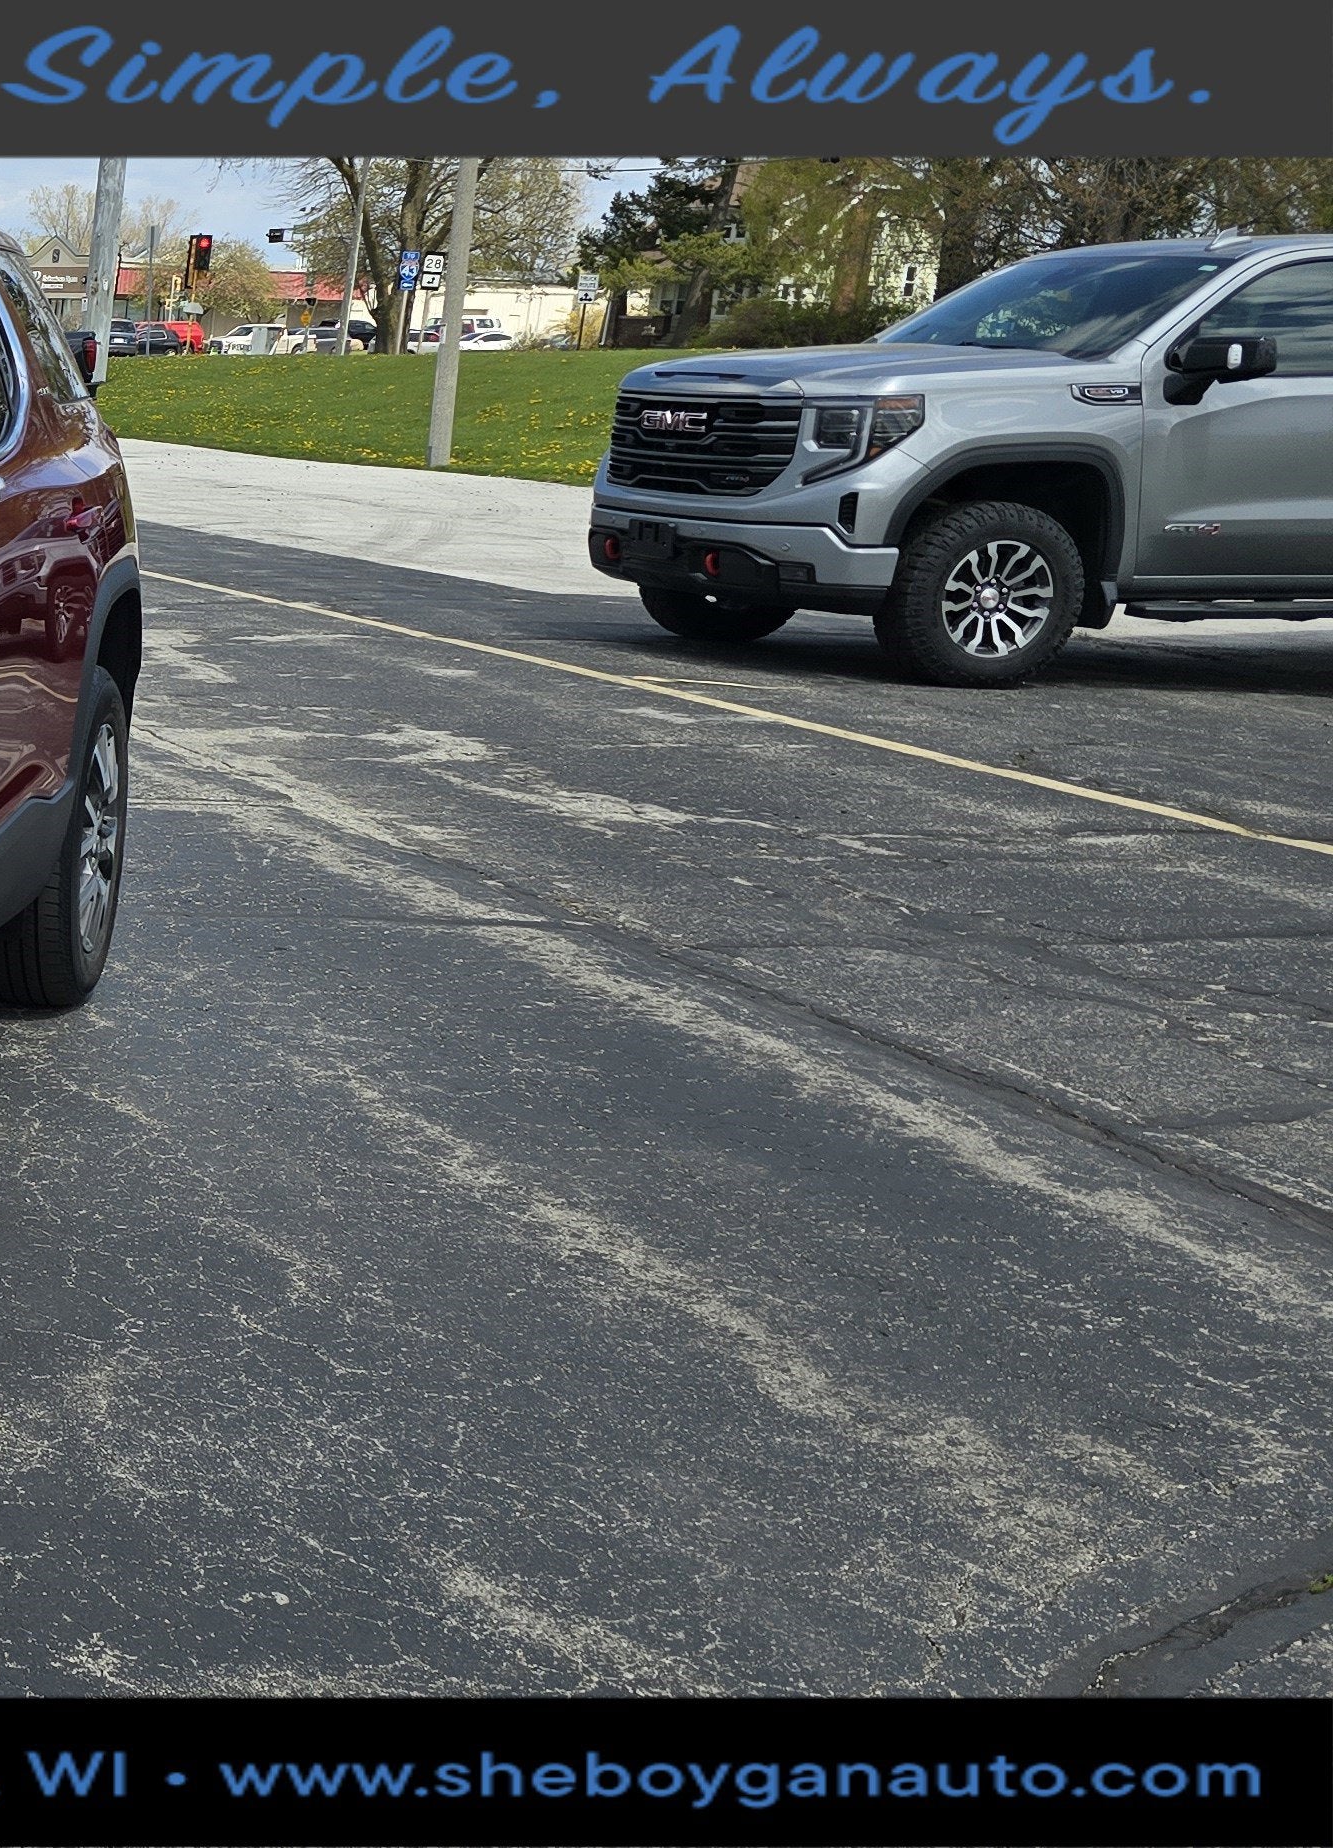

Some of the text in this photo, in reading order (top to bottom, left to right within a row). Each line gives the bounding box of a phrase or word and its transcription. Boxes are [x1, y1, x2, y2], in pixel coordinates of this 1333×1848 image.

[425, 258, 442, 269] 28
[402, 264, 417, 276] 43
[640, 408, 708, 433] GMC
